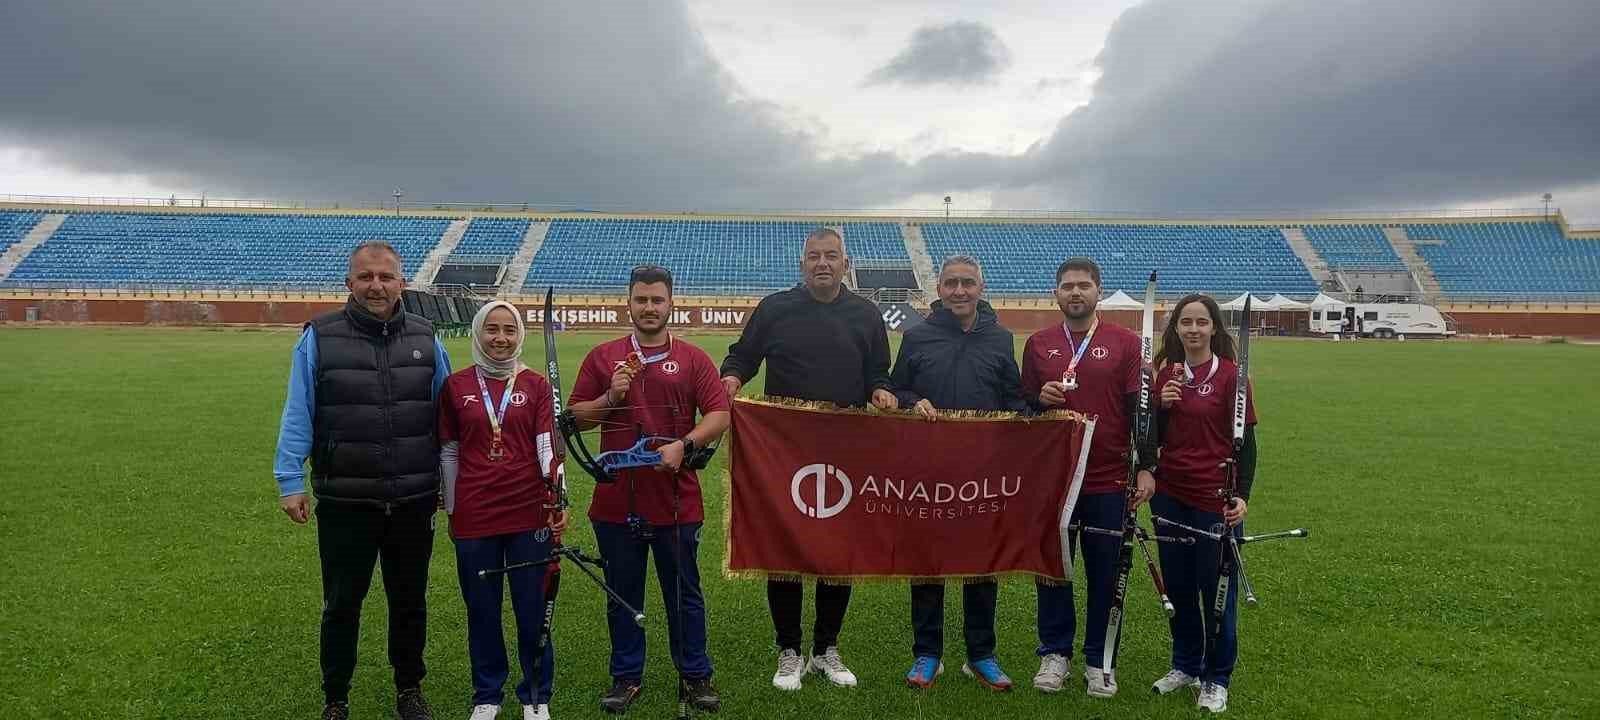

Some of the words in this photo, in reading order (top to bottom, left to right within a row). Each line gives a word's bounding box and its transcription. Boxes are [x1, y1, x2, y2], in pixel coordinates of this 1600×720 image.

[1140, 371, 1150, 409] HOYT
[859, 475, 1022, 503] ANADOLU
[1116, 573, 1128, 601] HOYT
